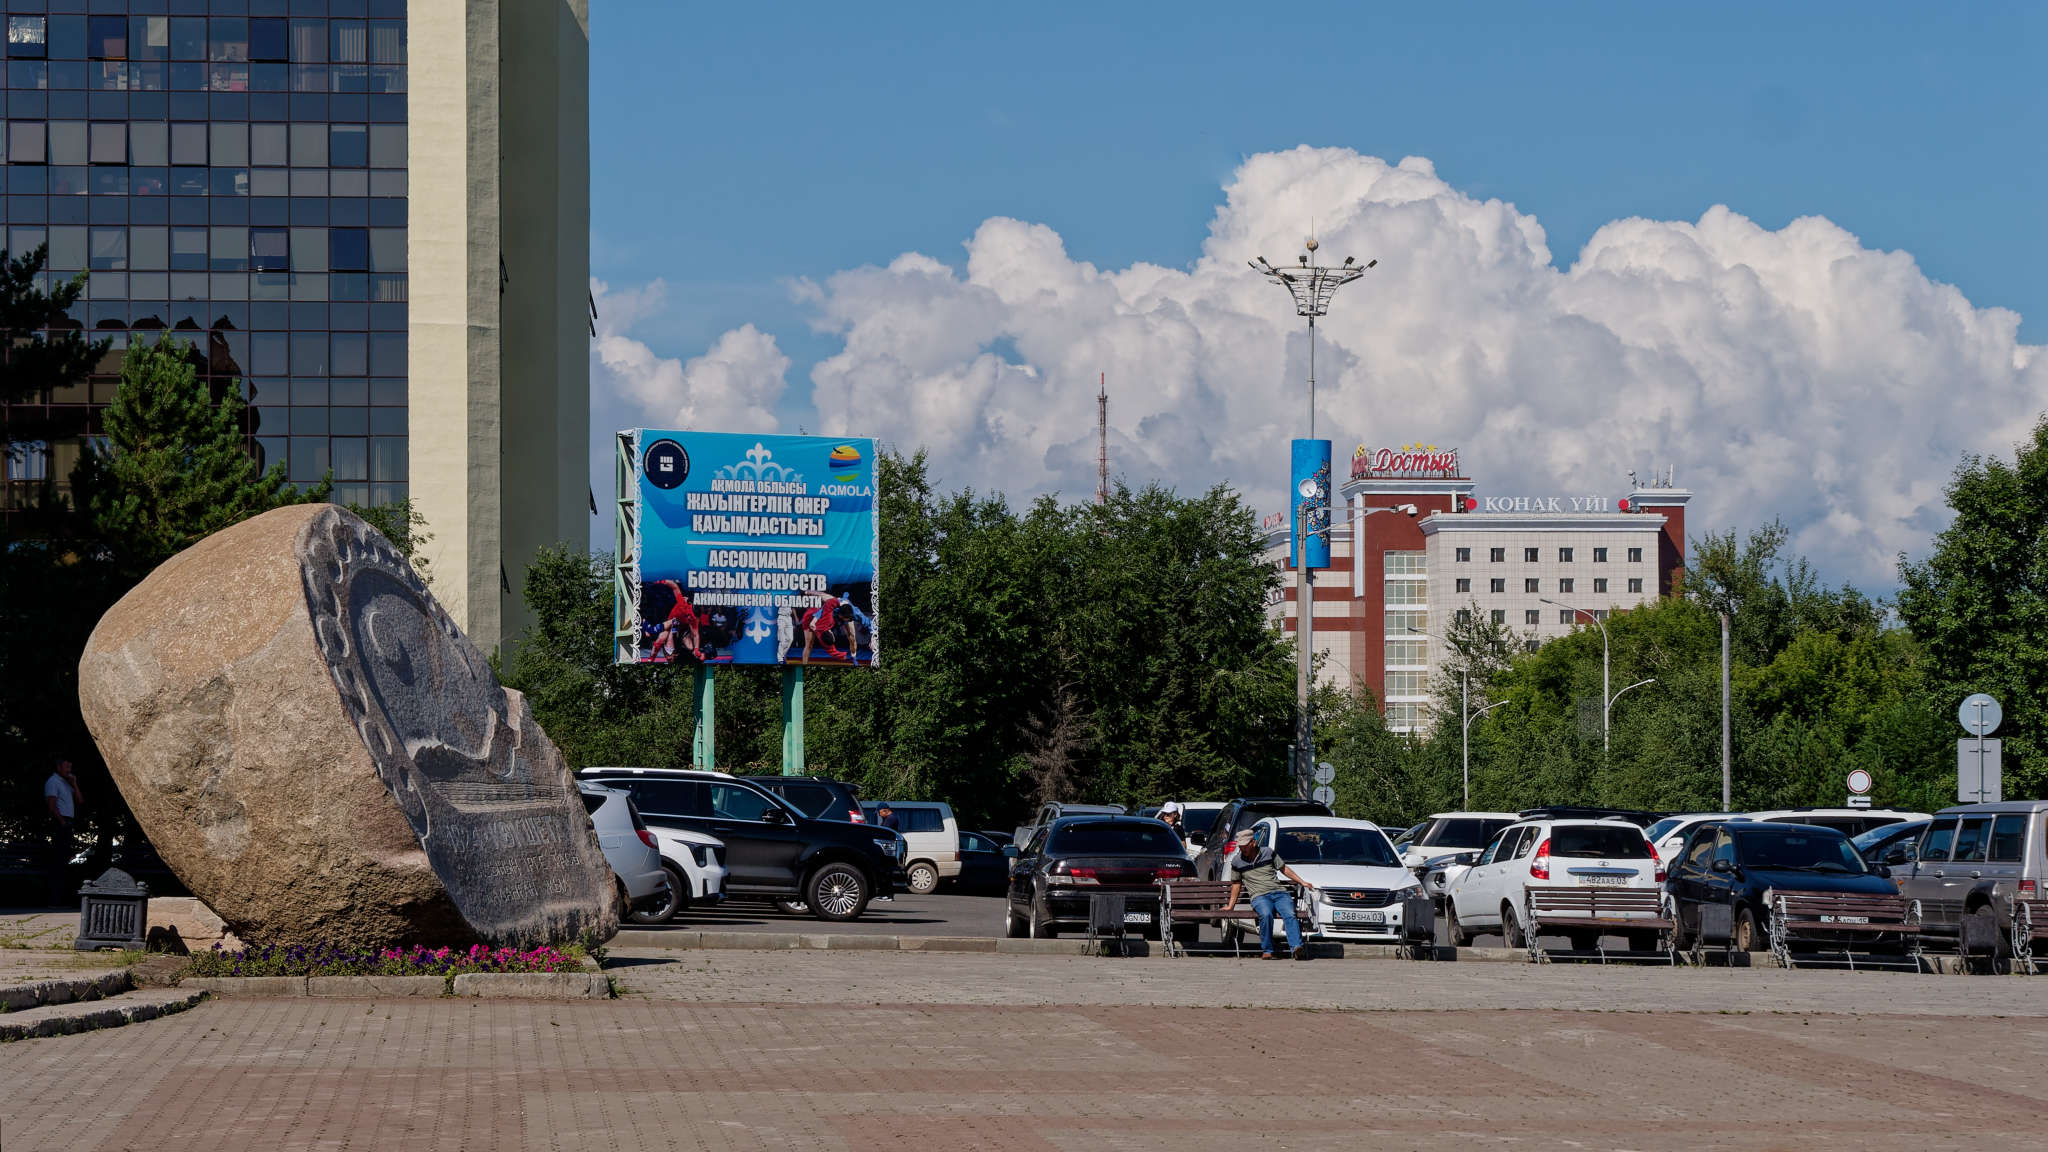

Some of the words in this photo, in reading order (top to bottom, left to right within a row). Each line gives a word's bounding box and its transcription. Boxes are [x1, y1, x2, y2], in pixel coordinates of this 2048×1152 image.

[711, 479, 755, 494] АҚМОЛА
[757, 481, 807, 495] ОБЛЫСЫ
[818, 484, 872, 497] AQMOLA
[686, 493, 793, 514] ЖАУЫНГЕРЛІК
[794, 496, 830, 515] ӨНЕР
[1484, 496, 1561, 513] ҚОНАҚ
[1570, 494, 1609, 512] ҮЙІ
[692, 514, 824, 536] ҚАУЫМДАСТЫҒЫ
[708, 549, 807, 571] АССОЦИАЦИЯ
[687, 570, 750, 589] БОЕВЫХ
[752, 572, 827, 592] ИСКУССТВ
[693, 592, 772, 607] АКМОЛИНСКОЙ
[774, 595, 822, 609] ОБЛАСТИ
[1372, 911, 1383, 921] 03
